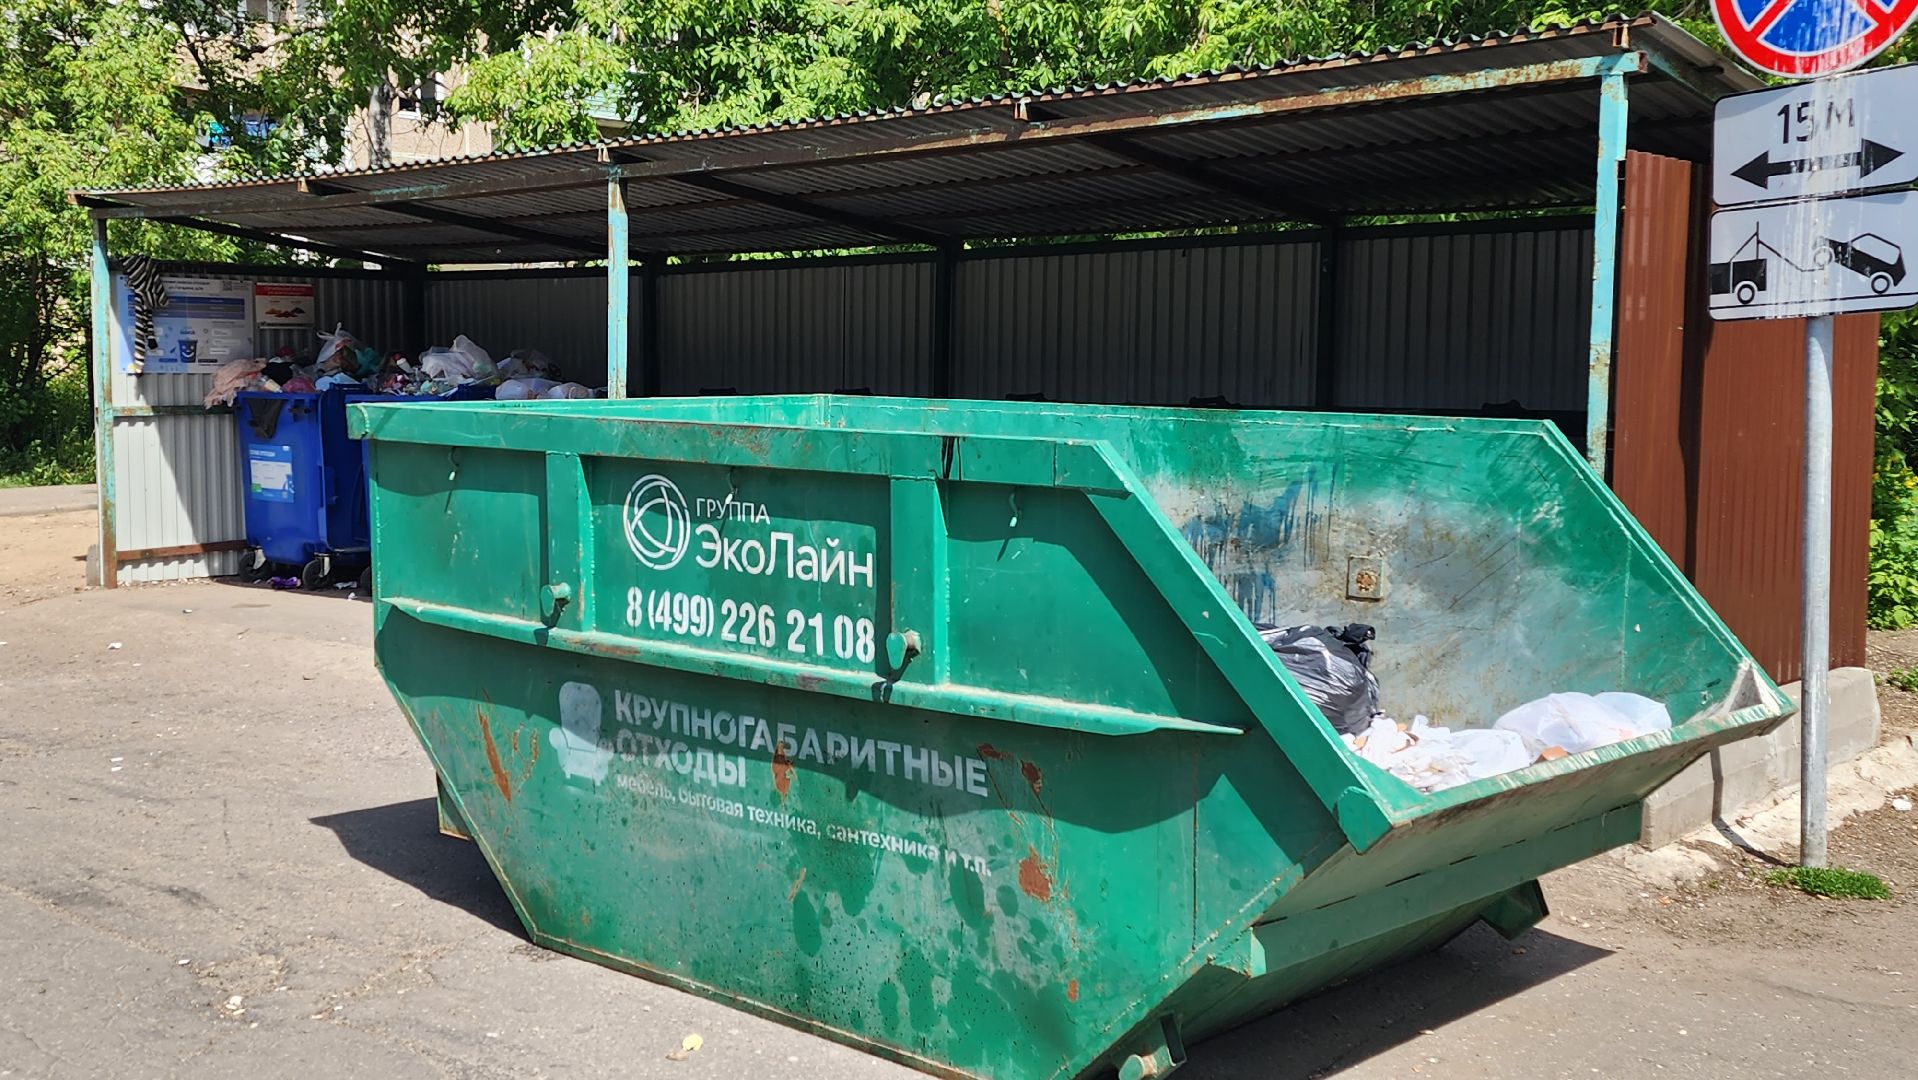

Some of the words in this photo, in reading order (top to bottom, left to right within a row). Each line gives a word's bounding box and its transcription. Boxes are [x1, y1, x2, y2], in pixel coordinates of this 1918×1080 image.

[1777, 100, 1817, 144] 15
[696, 498, 771, 525] ГРУППА
[695, 523, 873, 588] ЭкоЛайн
[720, 598, 776, 648] 226
[786, 608, 824, 657] 21
[833, 614, 876, 664] 08
[614, 689, 989, 797] КРУПНОГАБАРИТНЫЕ
[616, 727, 747, 788] ОТХОДЫ
[616, 773, 677, 803] мебель,
[679, 787, 743, 818] бытовая
[747, 803, 822, 841] техника,
[826, 821, 941, 861] сантехника
[945, 848, 957, 867] и
[963, 853, 993, 877] т.п.
